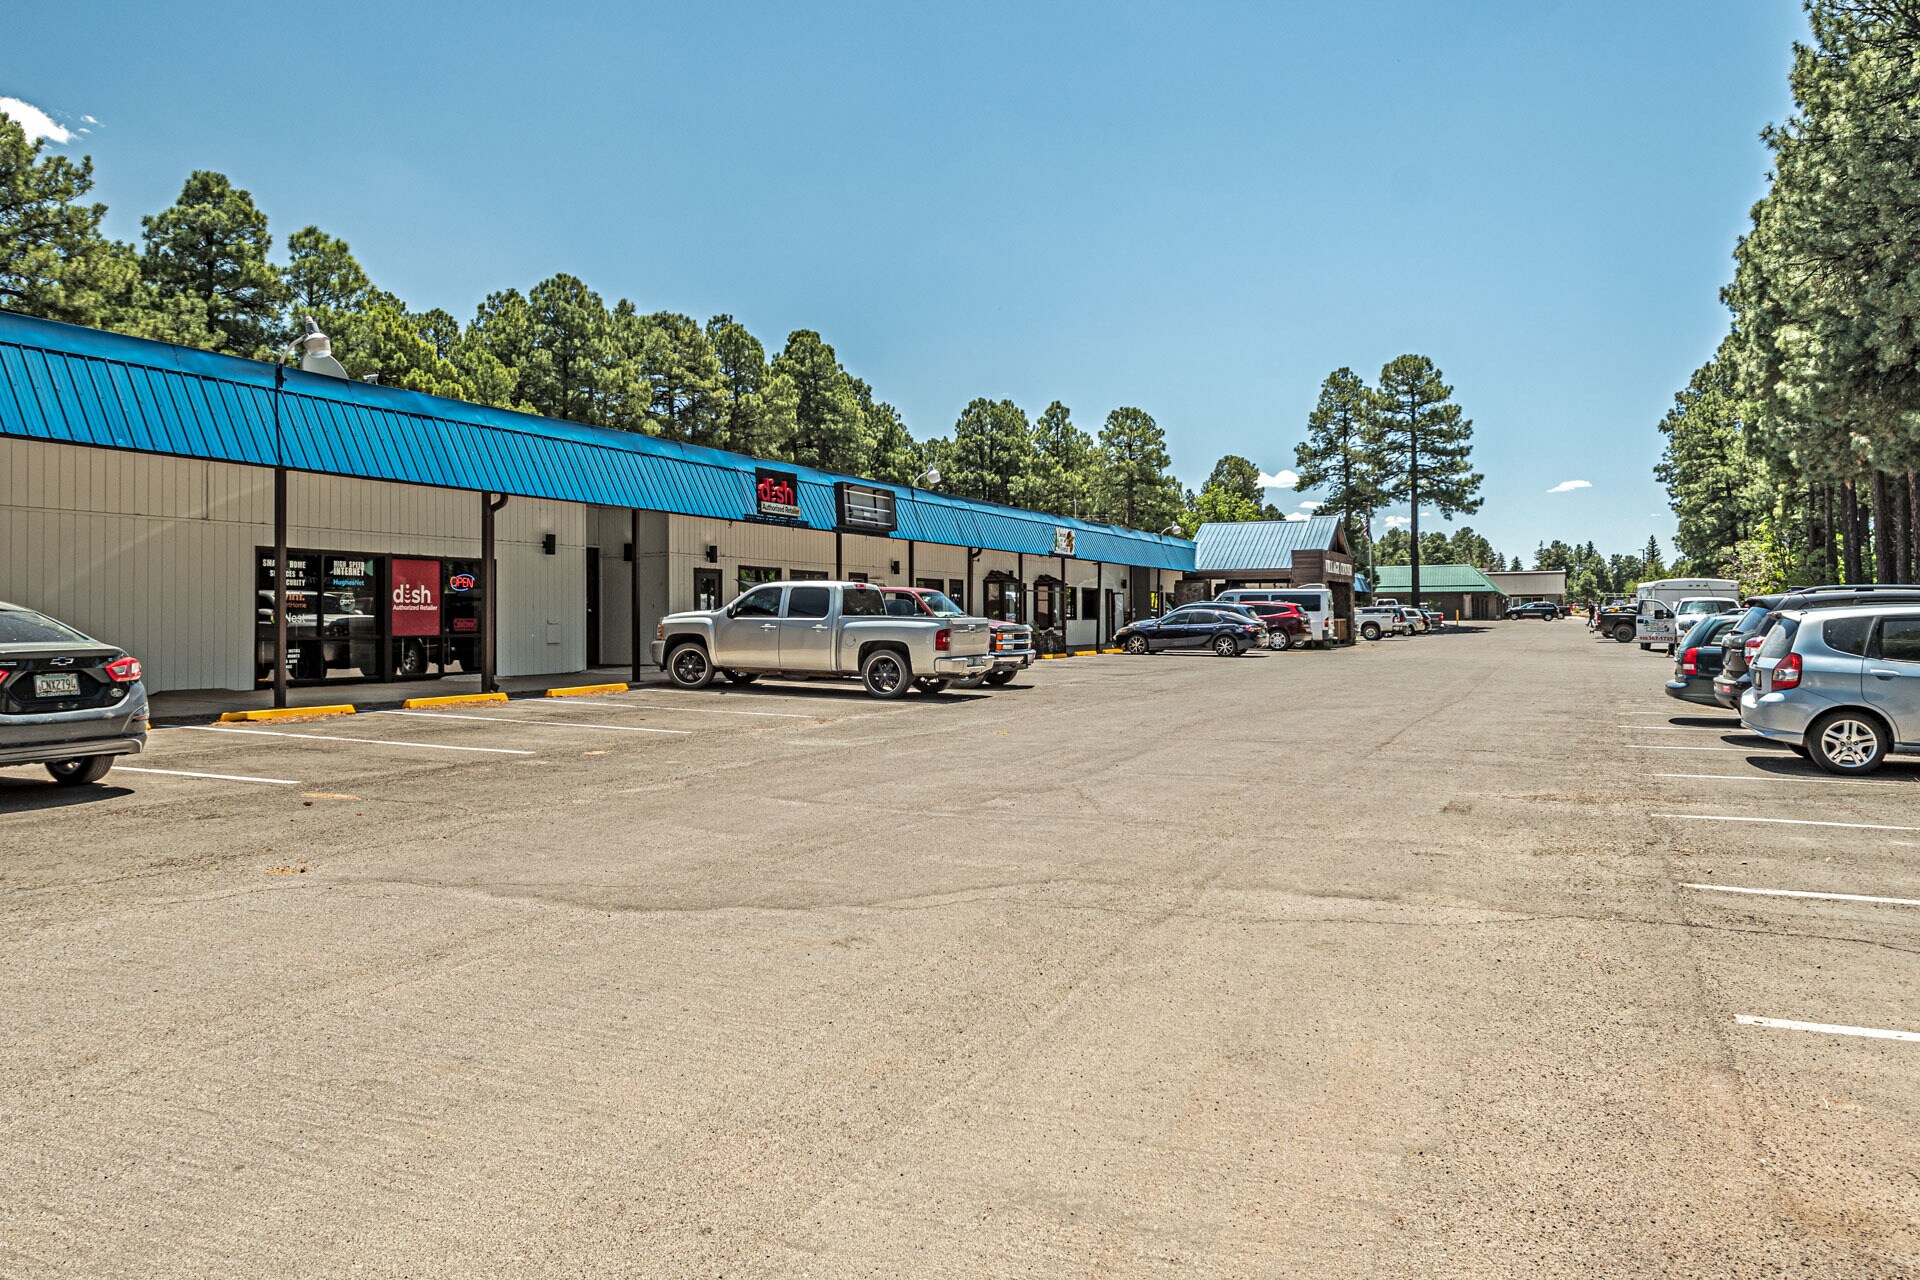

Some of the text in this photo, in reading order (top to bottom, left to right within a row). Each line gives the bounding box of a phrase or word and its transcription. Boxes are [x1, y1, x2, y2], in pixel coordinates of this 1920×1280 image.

[758, 478, 795, 505] dish
[762, 503, 800, 515] Authorized Retailer
[289, 560, 306, 569] HOME
[333, 560, 365, 569] HIGH SPEED
[333, 567, 365, 577] INTERNET
[285, 579, 306, 587] CURITY
[332, 579, 365, 587] HughesNet
[450, 576, 475, 589] OPEN
[393, 584, 432, 603] dish
